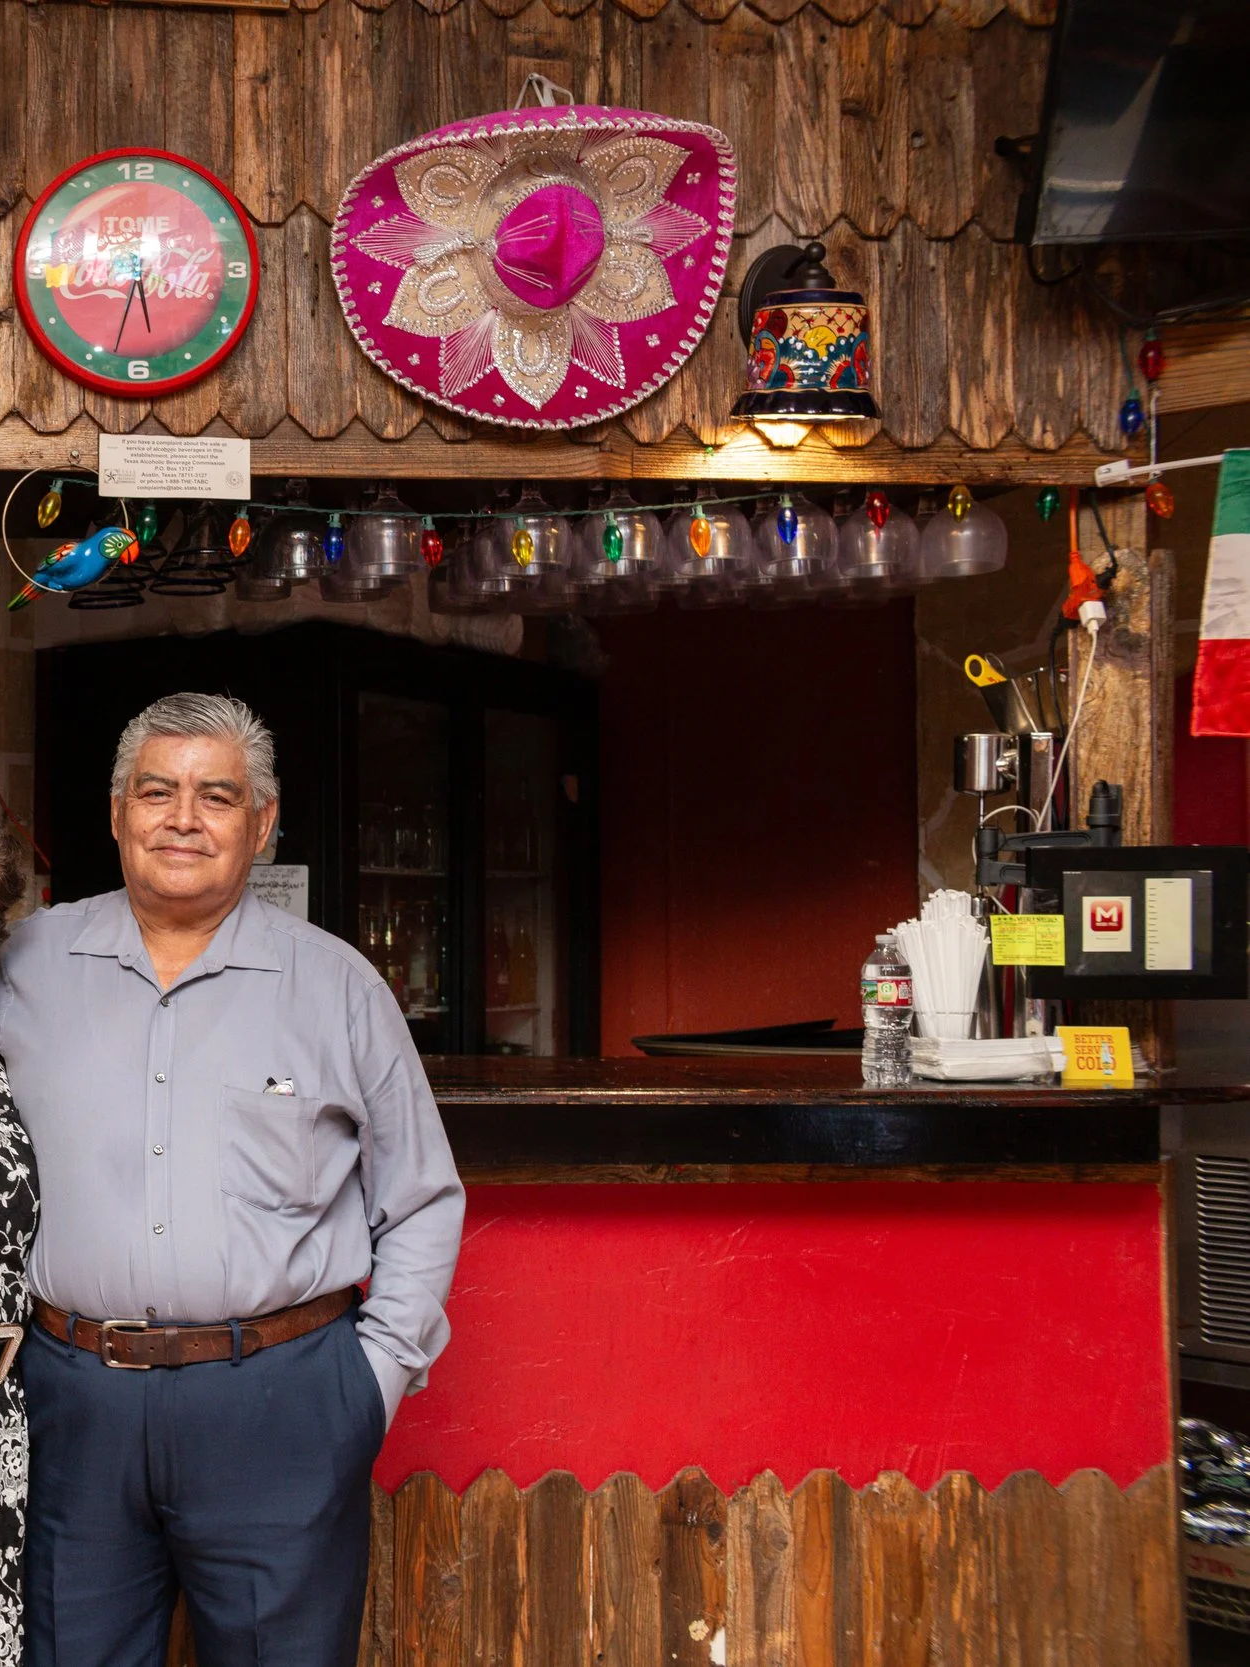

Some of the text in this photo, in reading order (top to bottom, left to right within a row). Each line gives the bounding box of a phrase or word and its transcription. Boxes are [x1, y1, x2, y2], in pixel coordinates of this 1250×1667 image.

[117, 162, 155, 180] 12
[104, 216, 170, 234] TOME
[59, 247, 216, 300] CocCola
[227, 262, 247, 279] 3
[127, 360, 150, 380] 6
[1096, 905, 1119, 922] M
[1074, 1034, 1114, 1044] BETTER
[1075, 1045, 1115, 1055] SERVD
